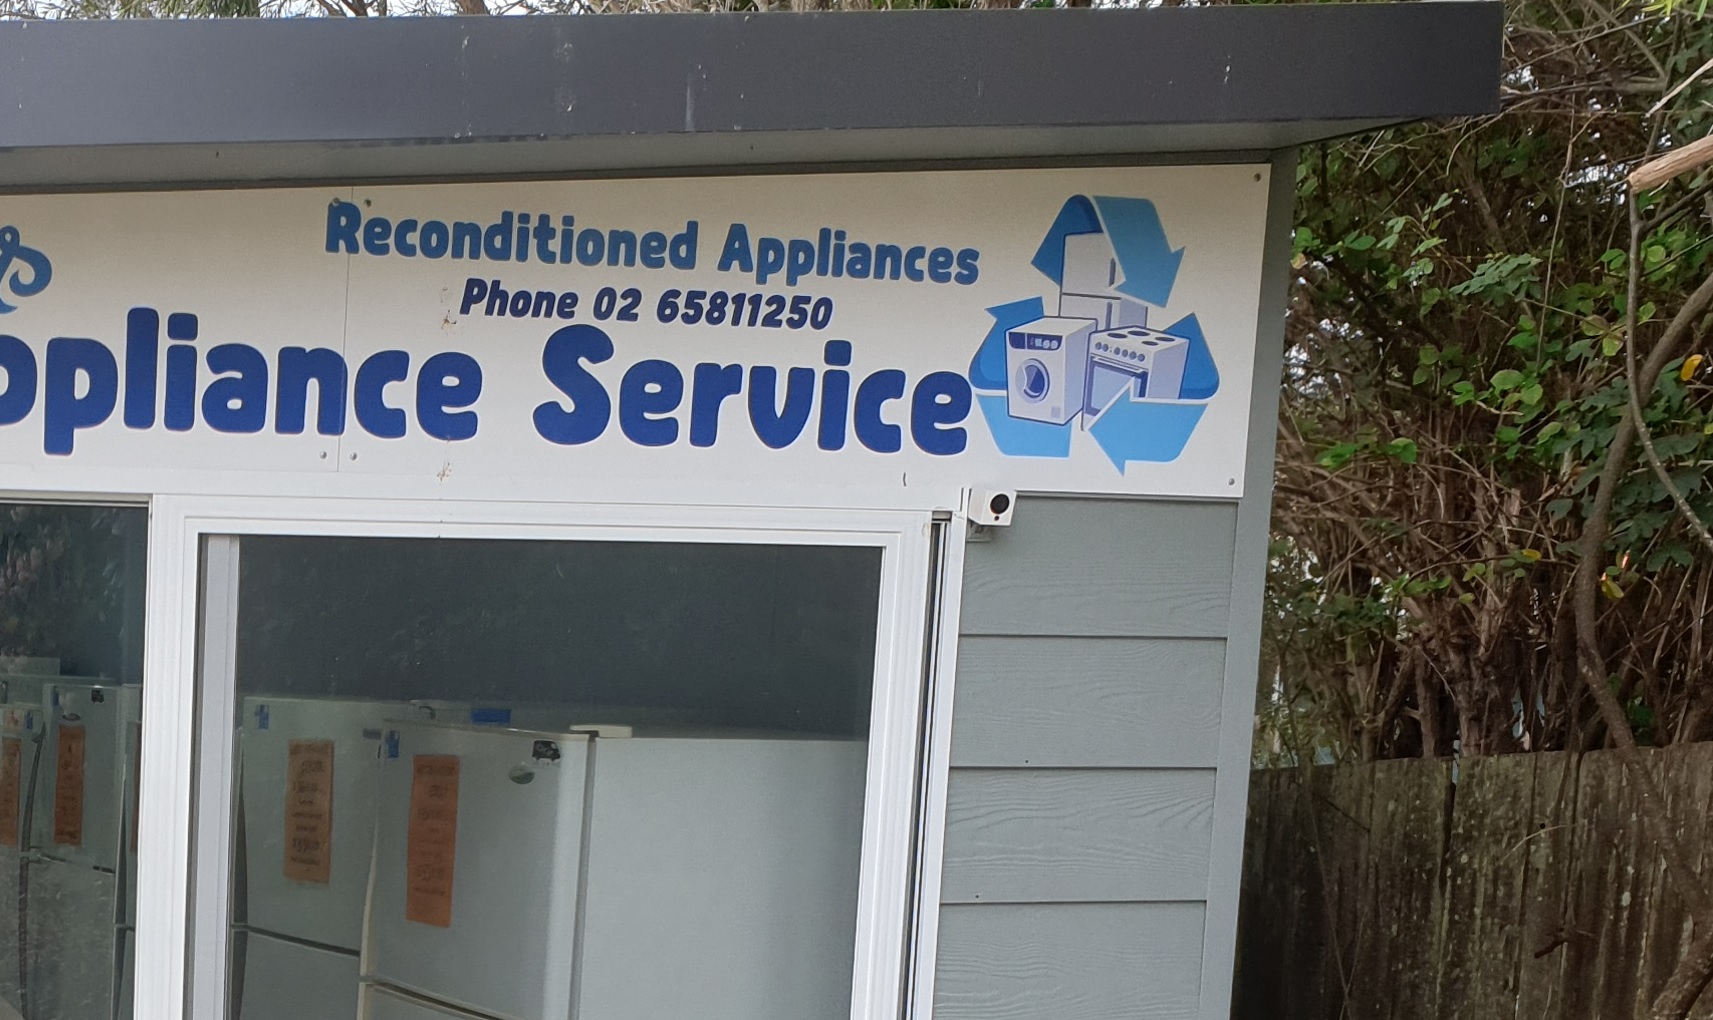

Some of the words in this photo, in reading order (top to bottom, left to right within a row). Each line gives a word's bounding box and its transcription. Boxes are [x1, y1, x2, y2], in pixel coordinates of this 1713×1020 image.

[326, 202, 699, 269] Reconditioned
[718, 223, 980, 286] Appliances
[460, 278, 579, 319] Phone
[594, 287, 641, 321] 02
[657, 289, 834, 330] 65811250
[532, 324, 974, 456] Service
